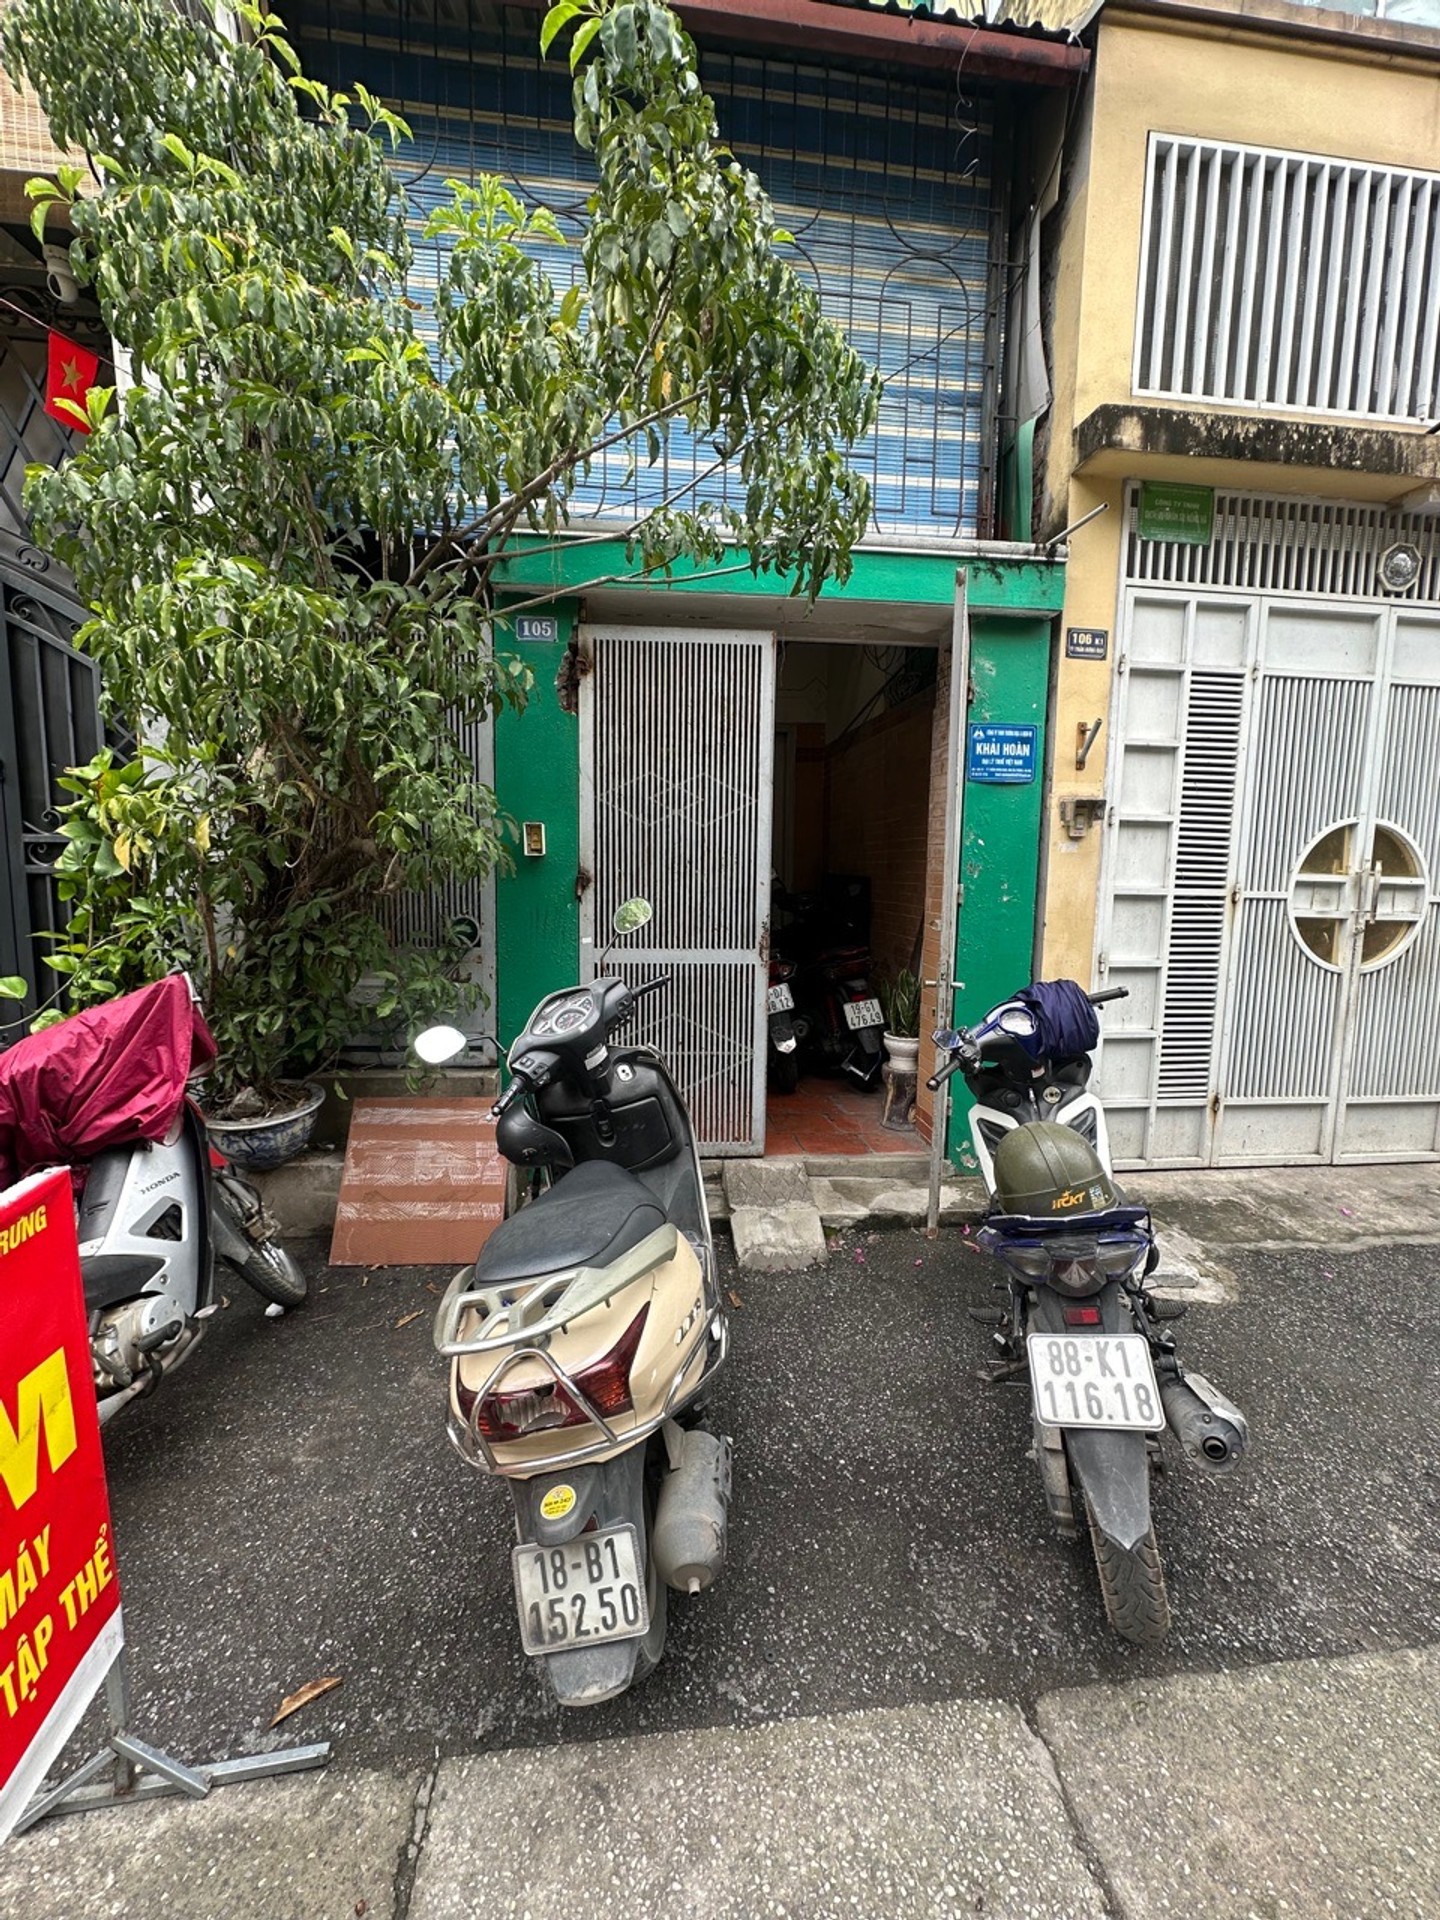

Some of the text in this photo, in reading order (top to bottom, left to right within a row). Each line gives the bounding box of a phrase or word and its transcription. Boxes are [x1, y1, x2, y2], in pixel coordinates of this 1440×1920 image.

[522, 621, 552, 637] 105
[1072, 633, 1092, 645] 106
[976, 738, 1031, 757] KHẢI HOÀN
[140, 1172, 181, 1195] HONDA
[1047, 1340, 1132, 1379] 88-K1
[1044, 1381, 1155, 1422] 116.18
[534, 1537, 620, 1595] 18-B1
[0, 1522, 114, 1719] TẬP THỂ
[529, 1583, 640, 1646] 152.50
